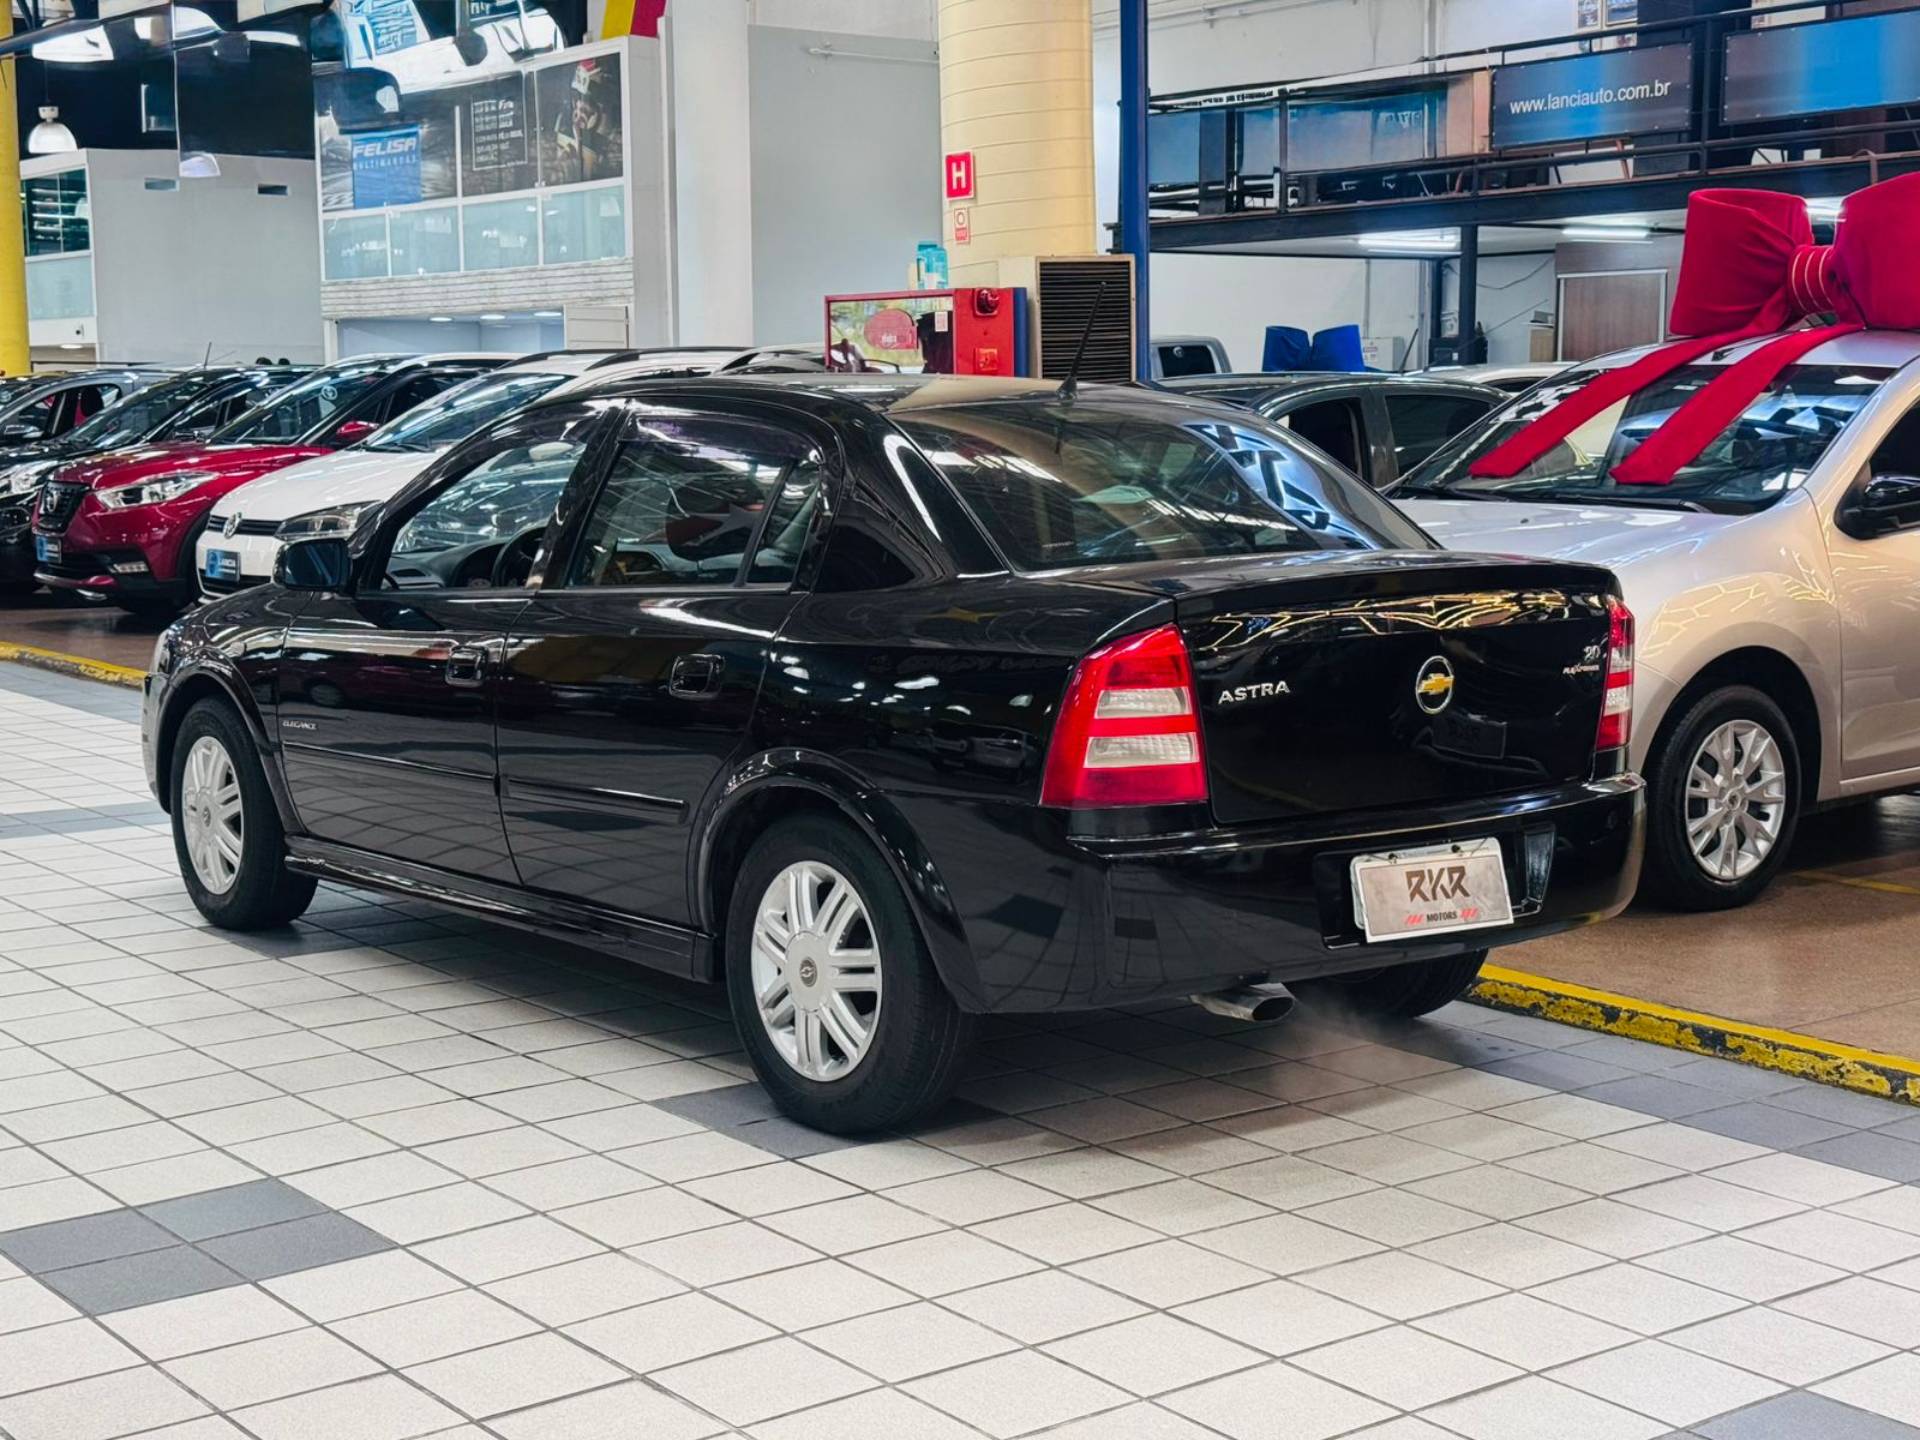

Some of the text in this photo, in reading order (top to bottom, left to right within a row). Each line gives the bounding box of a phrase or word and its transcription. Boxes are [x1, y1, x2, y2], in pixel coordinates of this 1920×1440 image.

[1509, 79, 1672, 115] www.lanciauto.com.br
[951, 160, 967, 190] H
[1218, 680, 1290, 705] ASTRA
[1405, 865, 1471, 903] RKR
[1426, 911, 1458, 923] MOTORS
